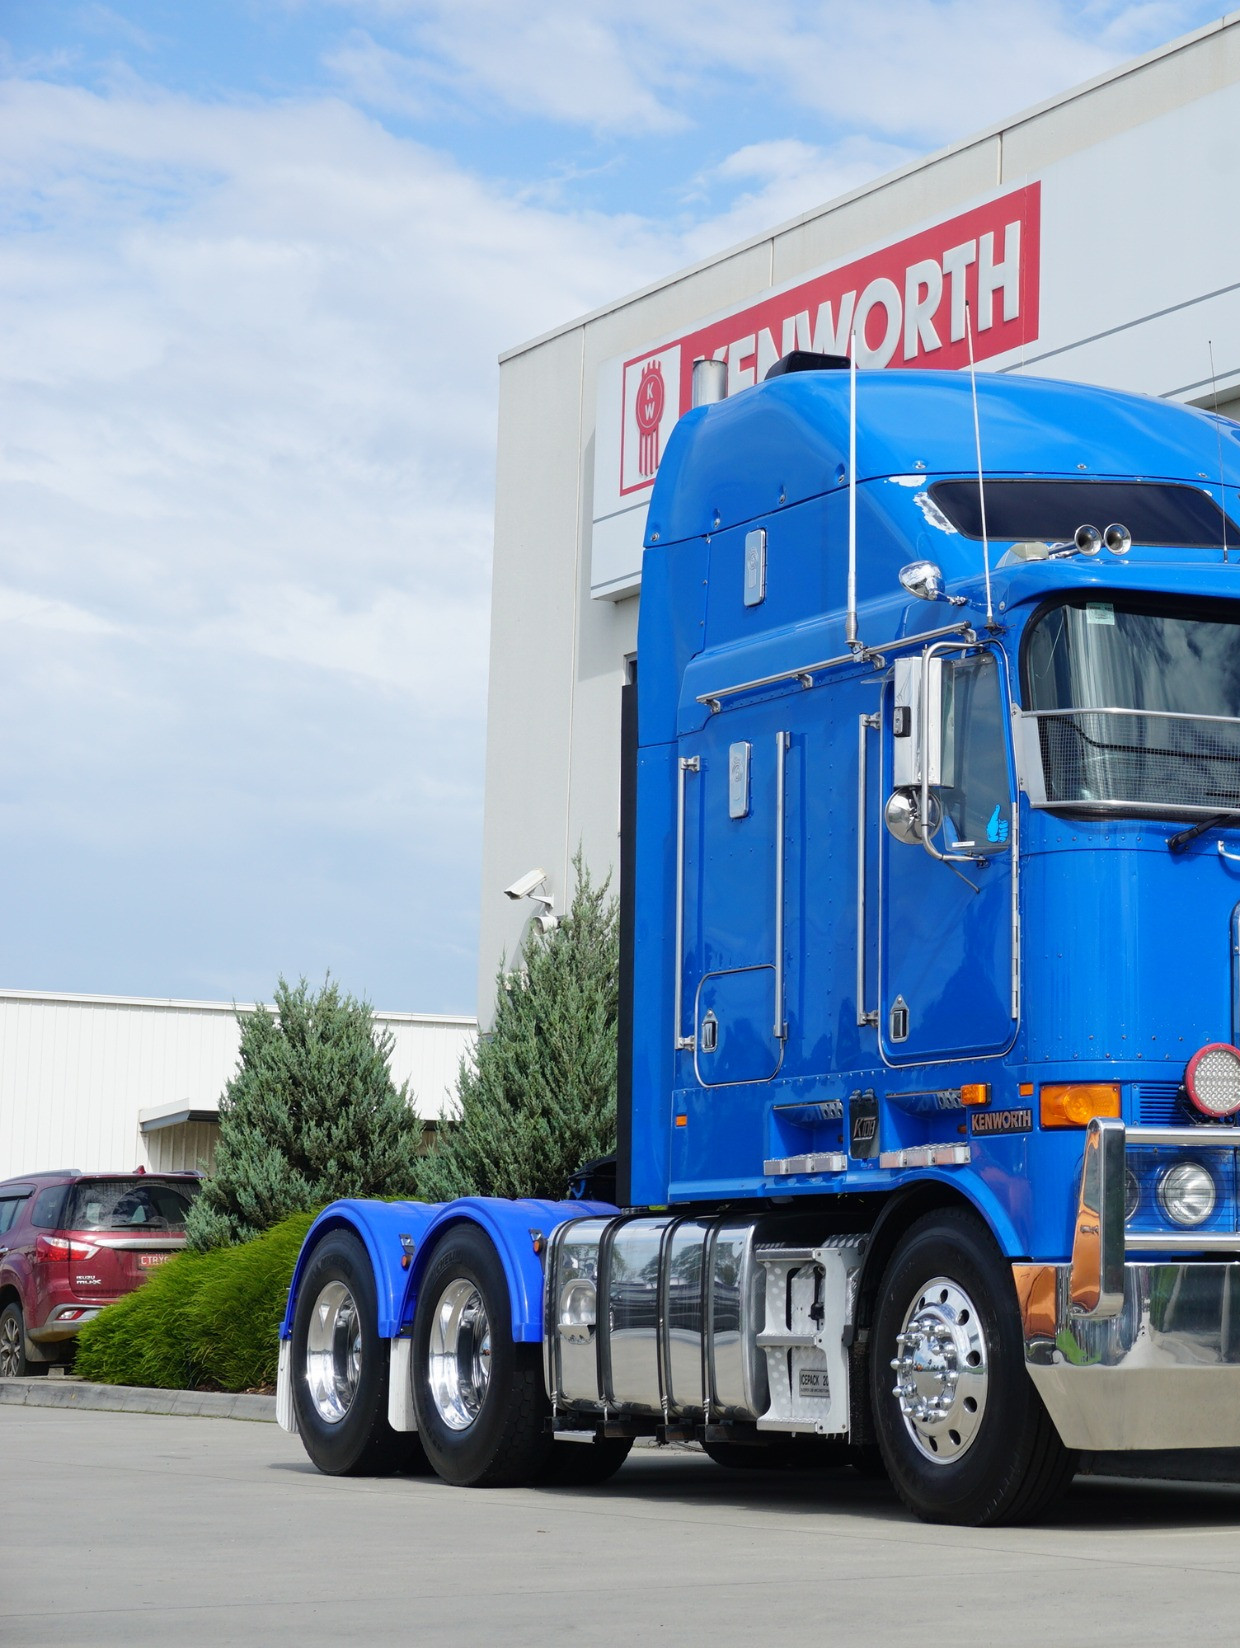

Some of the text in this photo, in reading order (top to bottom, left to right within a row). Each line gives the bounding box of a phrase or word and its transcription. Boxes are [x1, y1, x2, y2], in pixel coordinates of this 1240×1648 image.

[693, 220, 1021, 398] ENWORTH
[647, 381, 654, 400] K
[644, 401, 655, 421] W
[971, 1109, 1032, 1131] KENWORTH
